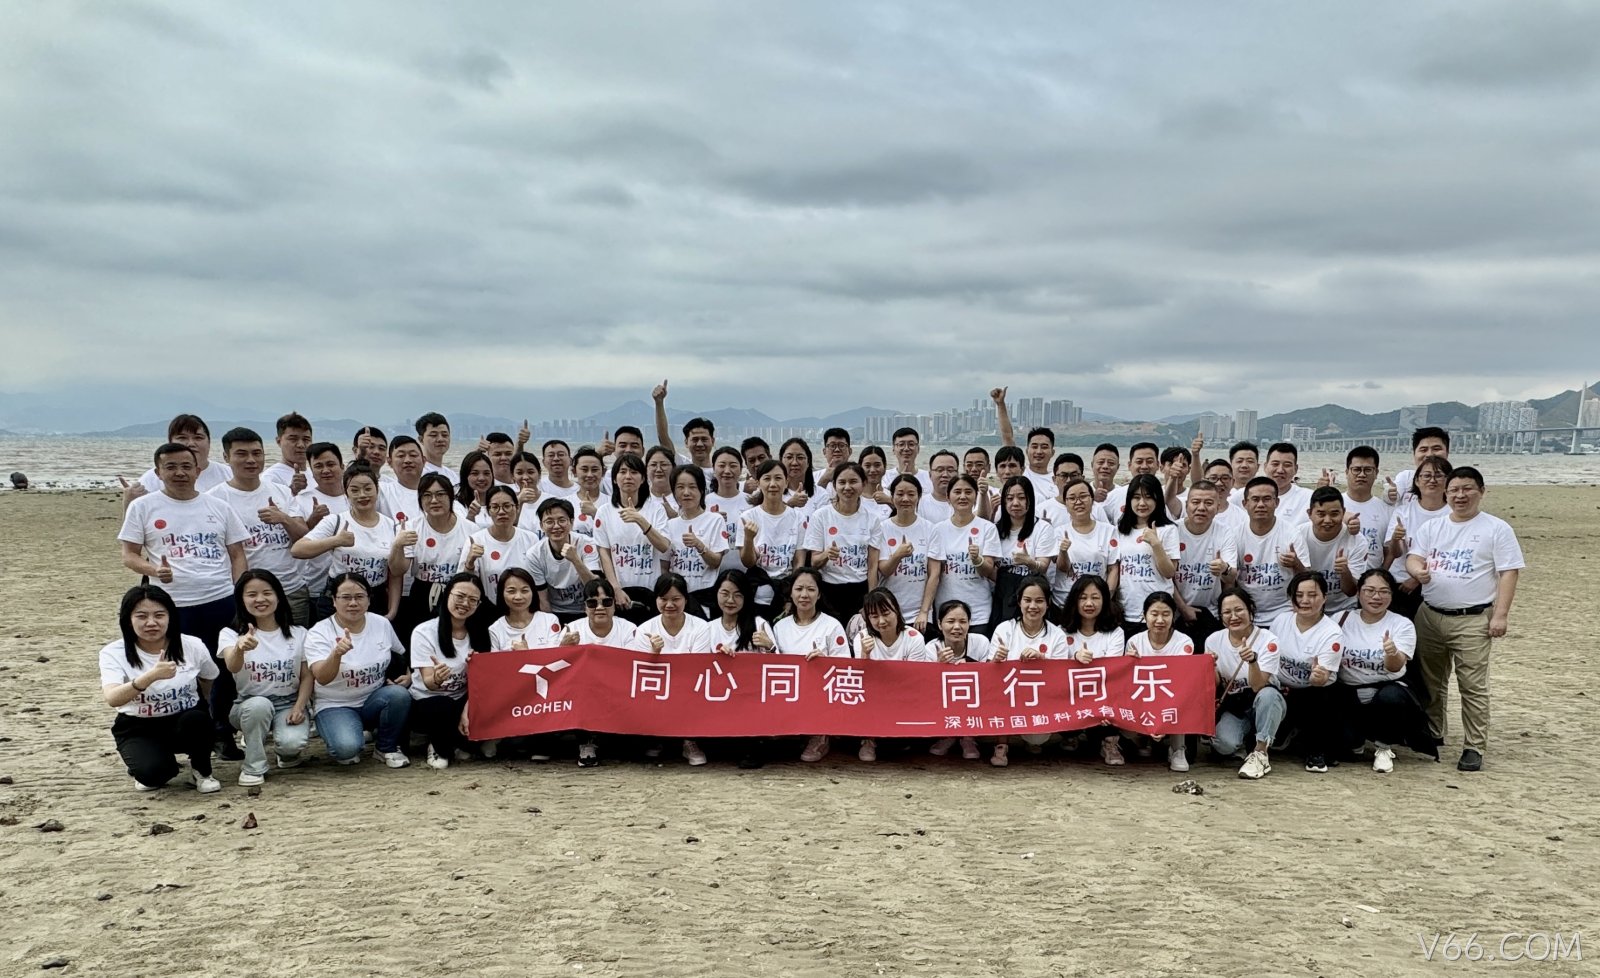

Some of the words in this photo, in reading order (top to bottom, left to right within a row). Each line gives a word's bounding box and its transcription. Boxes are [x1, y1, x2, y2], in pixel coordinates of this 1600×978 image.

[631, 659, 866, 705] 同心同德
[941, 663, 1175, 709] 同行同乐
[511, 700, 573, 717] GOCHEN
